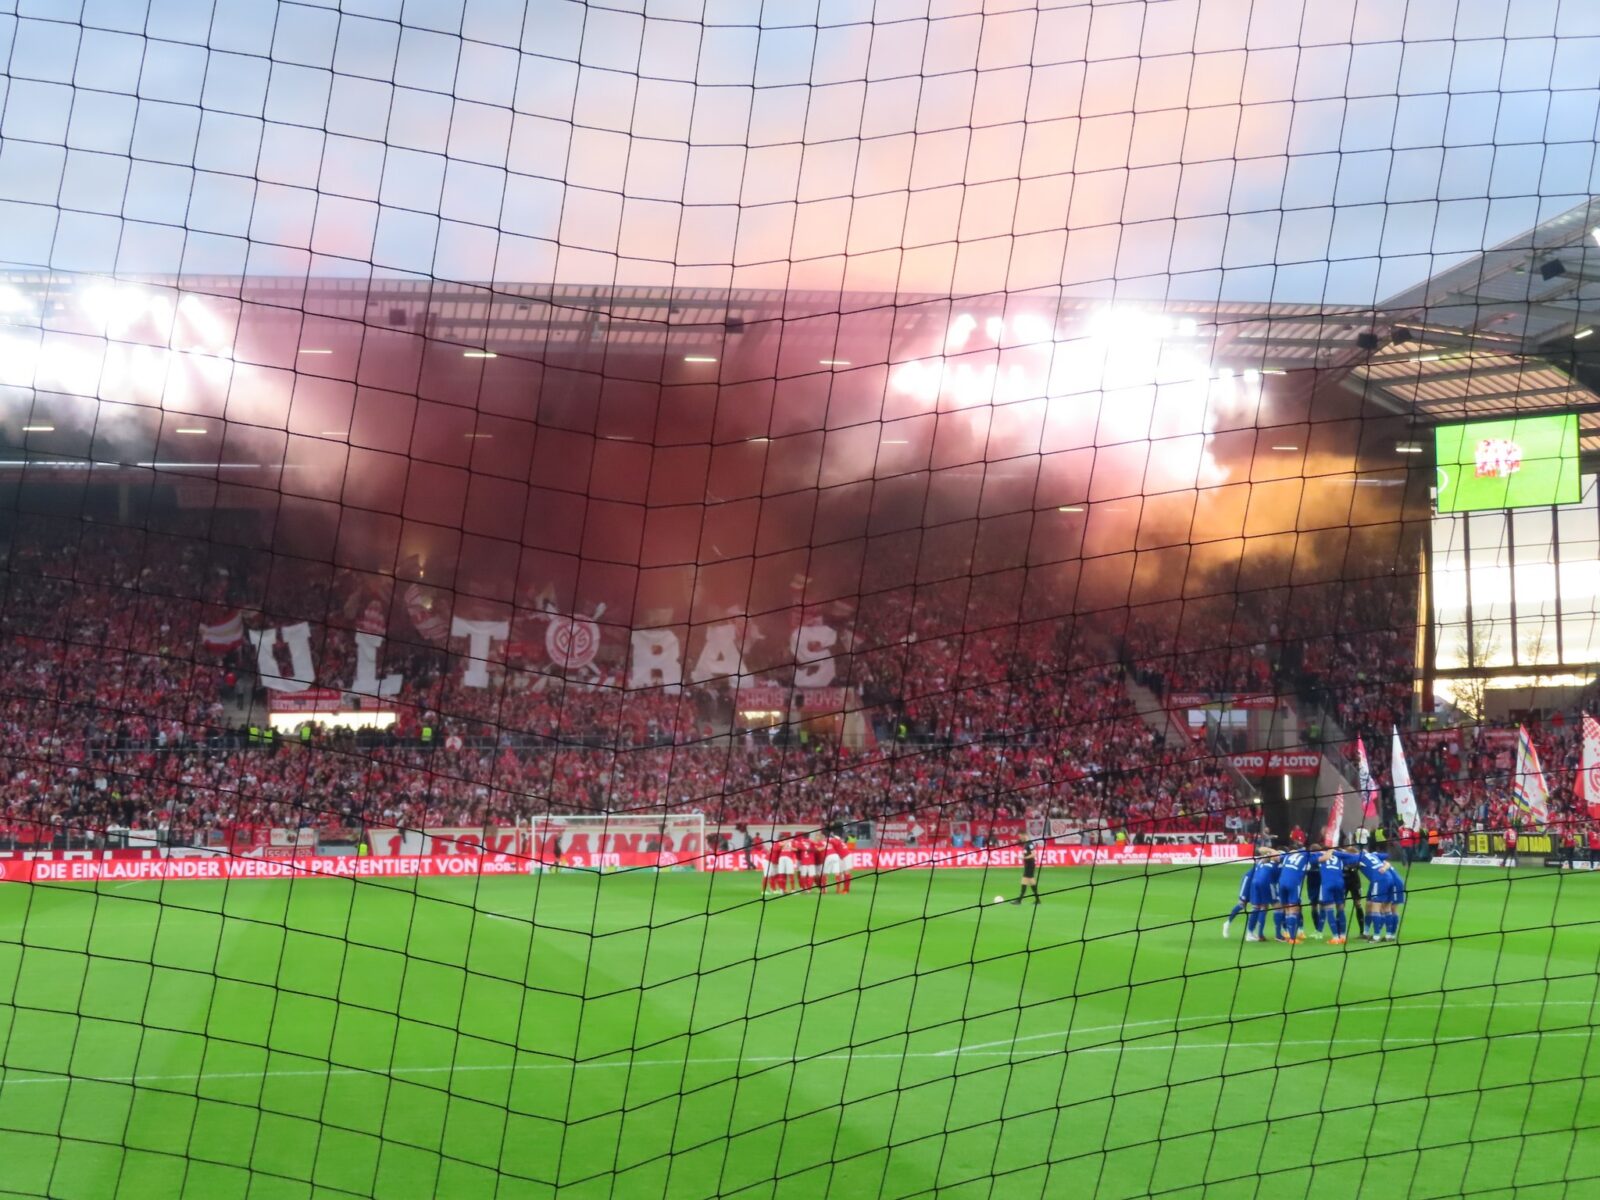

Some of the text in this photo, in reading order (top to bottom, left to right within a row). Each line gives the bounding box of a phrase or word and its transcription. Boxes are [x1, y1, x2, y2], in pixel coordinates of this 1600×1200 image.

[1283, 755, 1319, 767] LOTTO
[706, 853, 736, 869] DIE
[878, 852, 945, 867] WERDEN
[956, 848, 1067, 867] PRÄSENIERT
[1070, 848, 1108, 865] VON
[37, 856, 477, 879] DIE EINLAUFKINDER WERDEN PRÄSENTIERT VON
